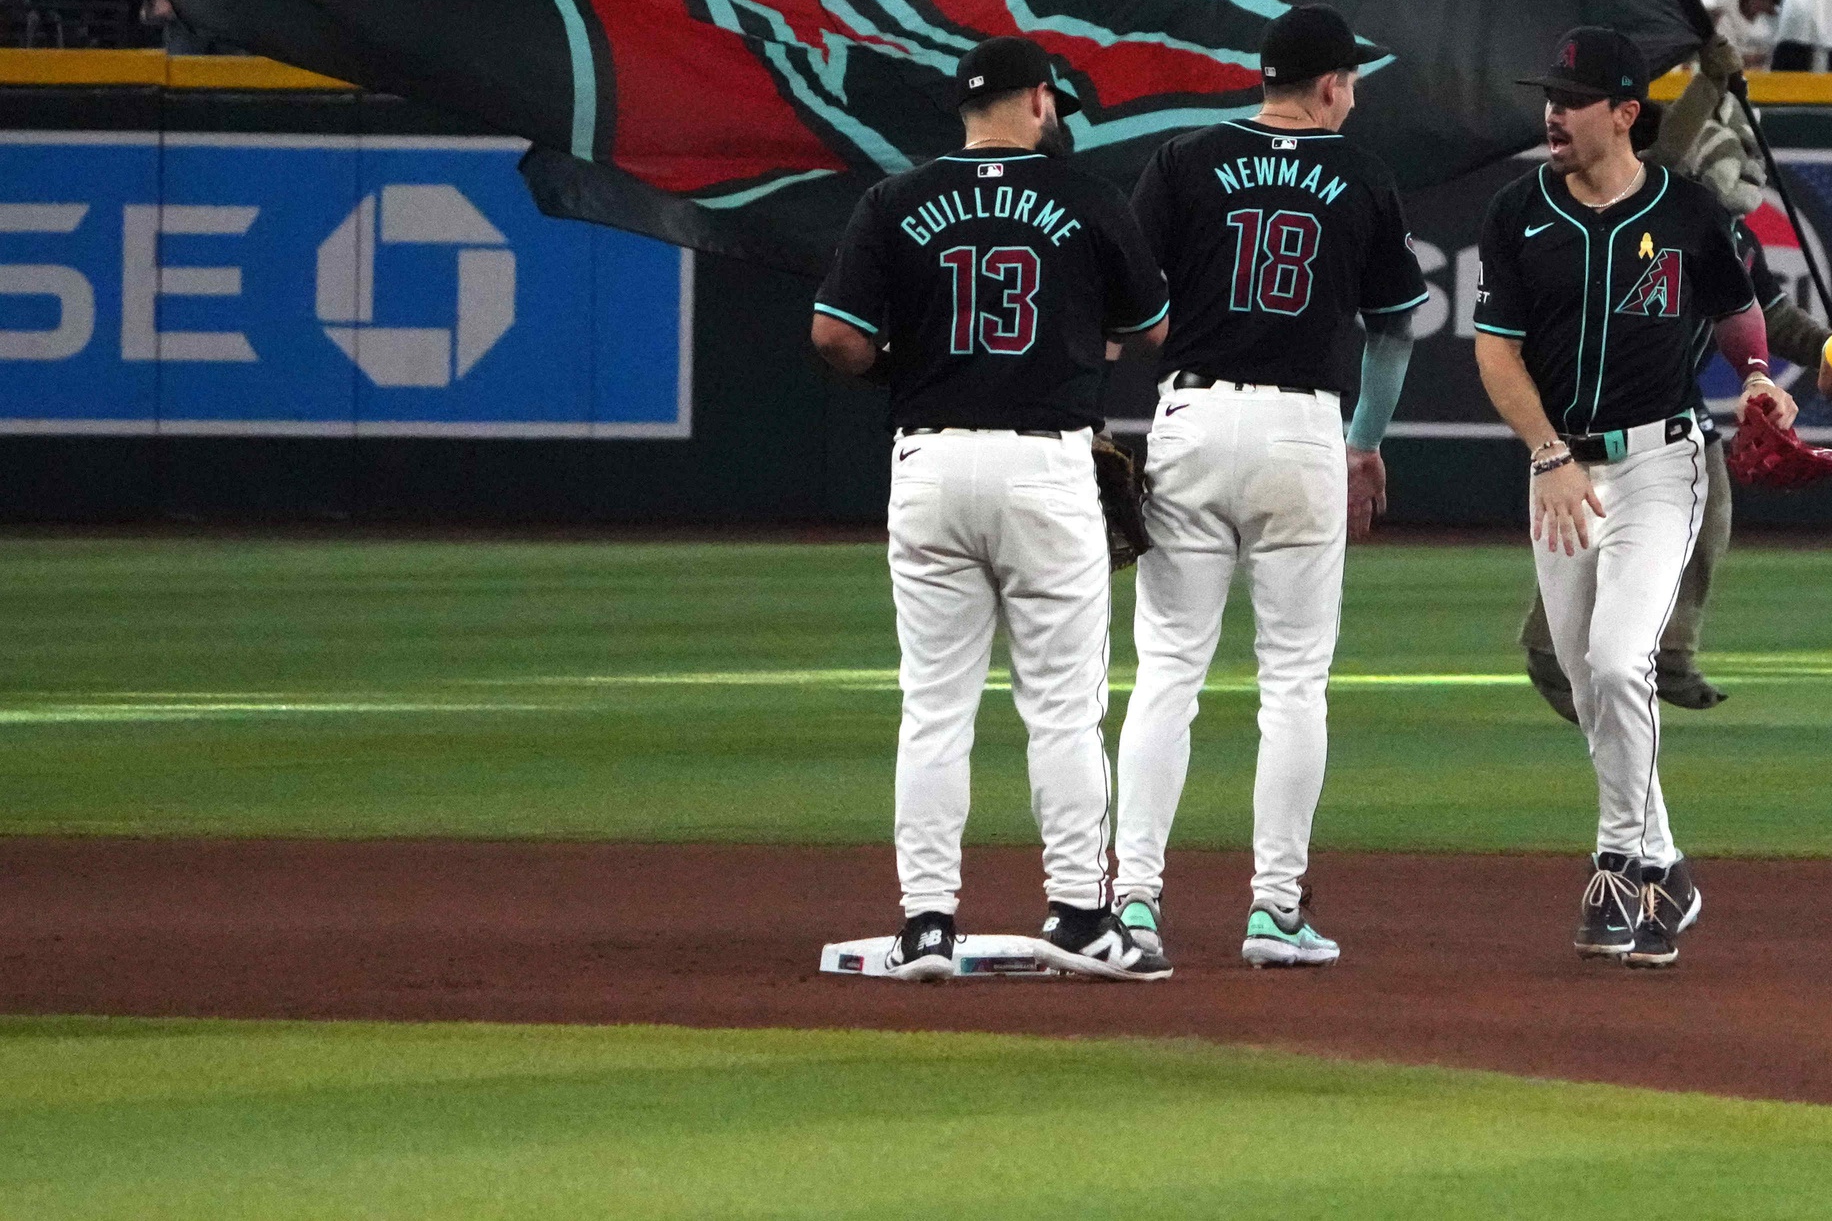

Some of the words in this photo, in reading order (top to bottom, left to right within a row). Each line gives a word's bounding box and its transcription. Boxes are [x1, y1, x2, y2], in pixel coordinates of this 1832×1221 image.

[900, 186, 1081, 247] GUILLORME
[1214, 156, 1347, 205] NEWMAN
[0, 202, 261, 362] SE
[939, 245, 1041, 355] 13
[1226, 208, 1322, 317] 18
